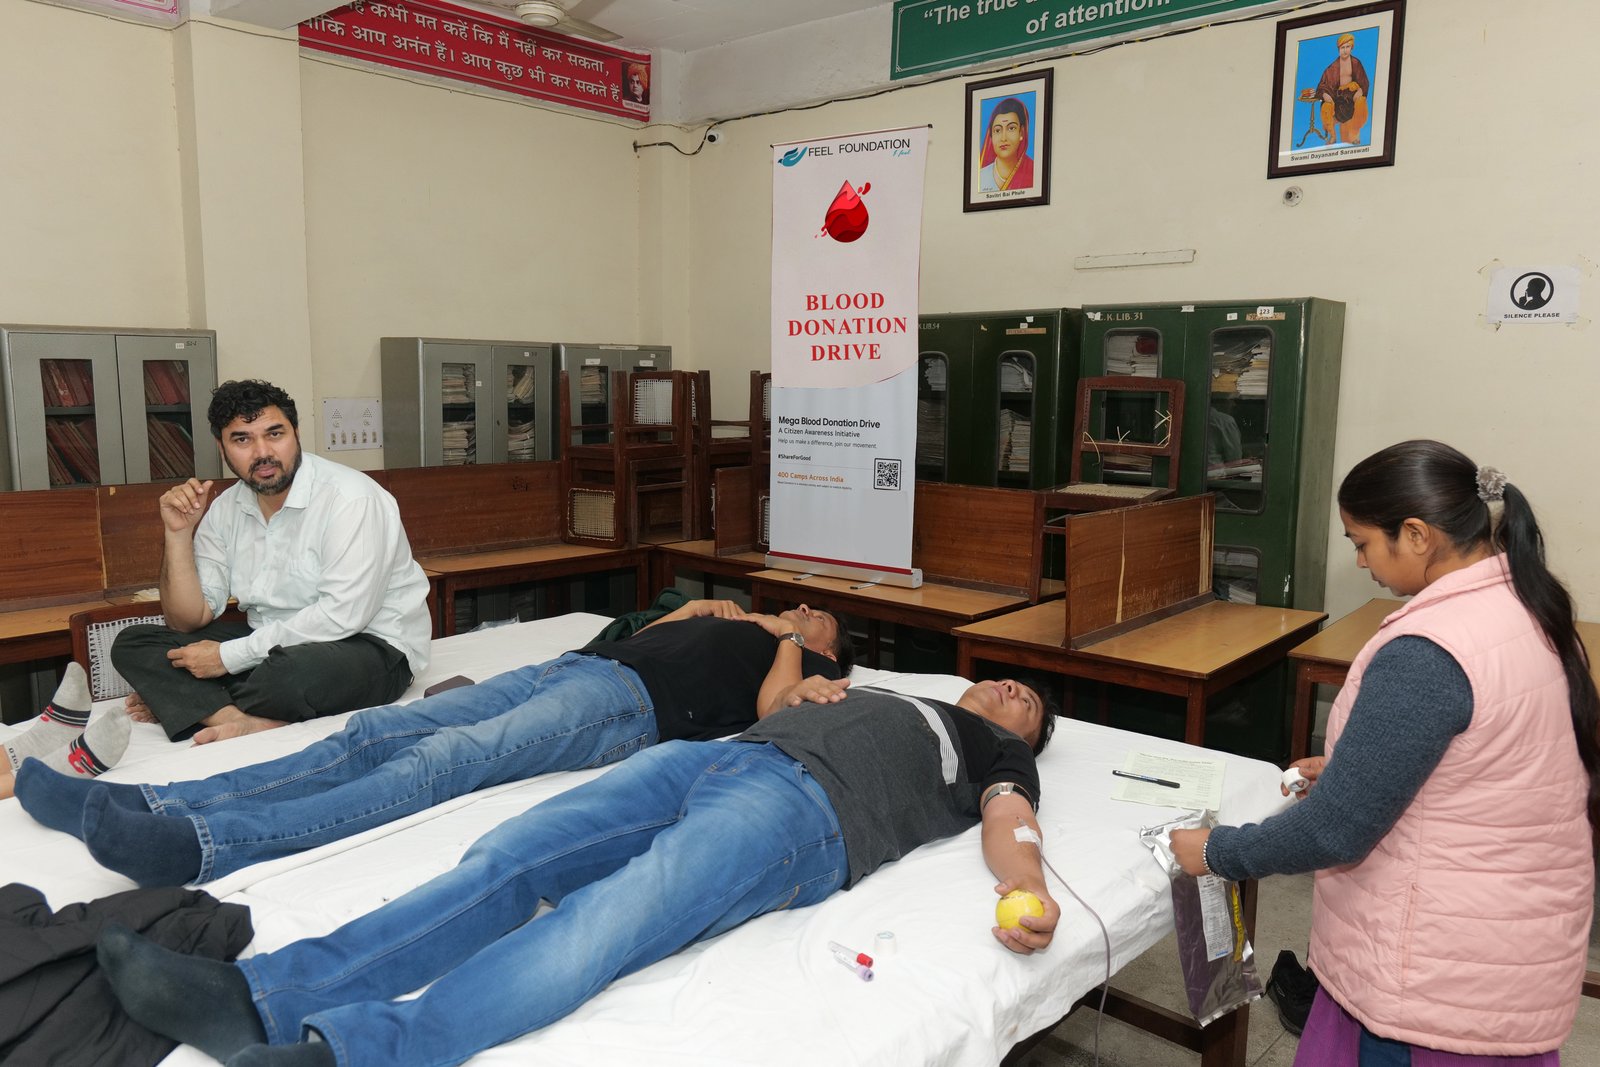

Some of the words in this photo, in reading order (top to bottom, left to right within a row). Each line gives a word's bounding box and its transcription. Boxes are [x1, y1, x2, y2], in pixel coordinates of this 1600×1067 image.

[367, 1, 409, 23] कभी
[413, 12, 437, 30] मत
[441, 19, 469, 40] कहें
[472, 24, 493, 45] कि
[497, 30, 510, 49] मैं
[513, 38, 537, 57] नहीं
[541, 46, 563, 63] कर
[1026, 11, 1050, 34] of
[351, 25, 387, 46] आप
[392, 34, 431, 56] अनंत
[461, 51, 492, 71] आप
[495, 59, 523, 81] कुछ
[528, 65, 546, 83] भी
[549, 73, 571, 89] कर
[574, 79, 608, 98] सकते
[610, 83, 620, 103] हैं
[808, 146, 833, 157] FEEL
[838, 138, 911, 154] FOUNDATION
[1311, 151, 1339, 160] Dayanand
[1340, 147, 1370, 155] Saraswati
[806, 292, 885, 312] BLOOD
[787, 316, 907, 337] DONATION
[810, 343, 882, 362] DRIVE
[778, 416, 800, 426] Mega
[801, 417, 821, 426] Blood
[822, 418, 858, 427] Donation
[859, 419, 880, 428] Drive
[784, 427, 804, 435] Citizen
[834, 430, 861, 438] Initiative
[777, 471, 789, 479] 400
[789, 472, 808, 481] Camps
[809, 474, 829, 482] Across
[829, 475, 844, 483] India
